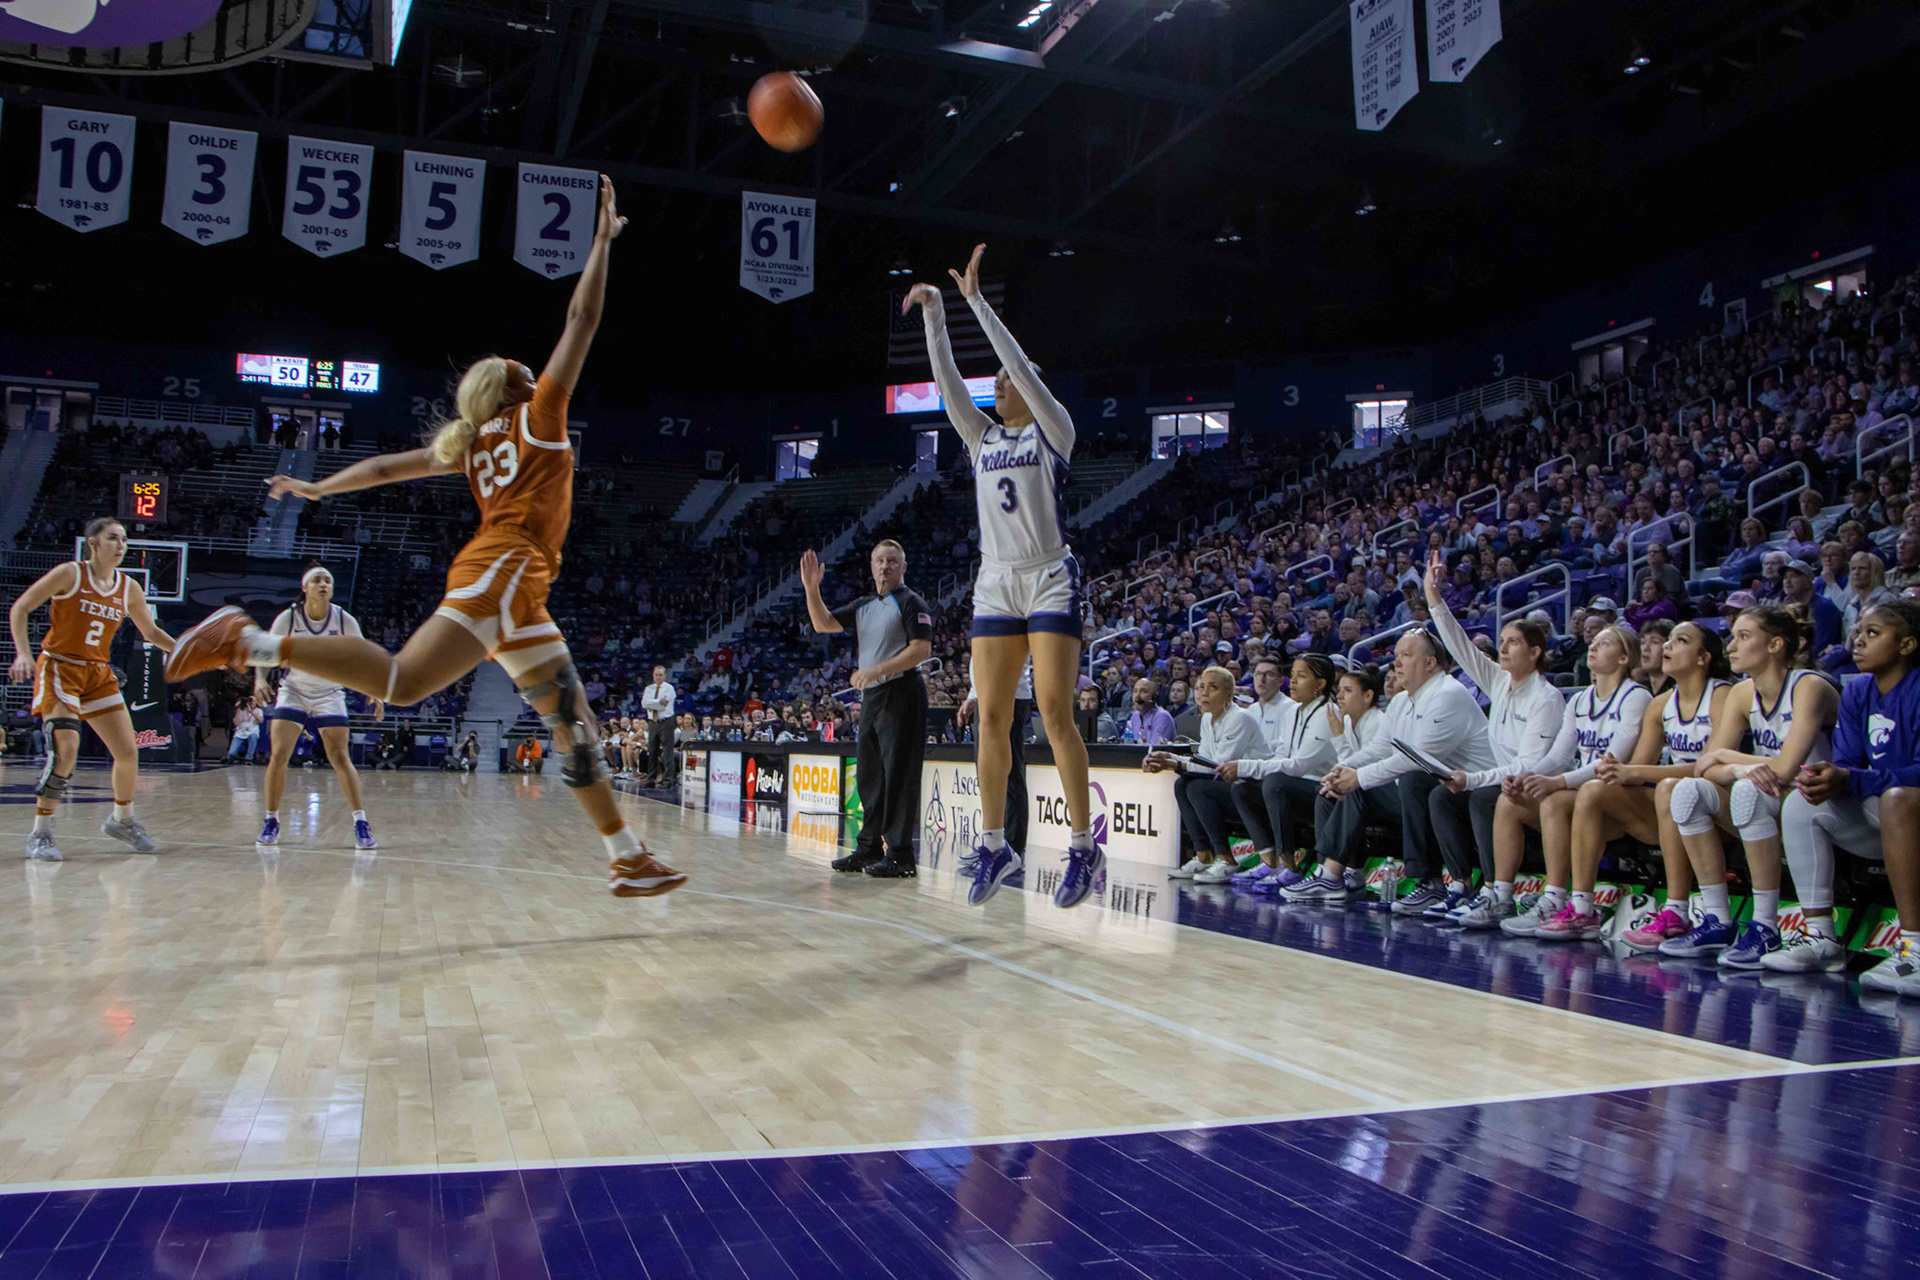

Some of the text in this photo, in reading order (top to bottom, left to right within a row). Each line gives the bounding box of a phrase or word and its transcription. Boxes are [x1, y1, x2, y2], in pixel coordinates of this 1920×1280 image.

[1463, 6, 1481, 26] 2023
[1370, 13, 1394, 41] AIAW
[1437, 23, 1455, 43] 2007
[1437, 37, 1455, 56] 2013
[68, 119, 110, 134] GARY
[188, 134, 238, 150] OHLDE
[50, 137, 123, 193] 10
[302, 147, 359, 165] WECKER
[191, 153, 227, 205] 3
[414, 161, 474, 179] LEHNING
[522, 172, 595, 190] CHAMBERS
[292, 165, 362, 220] 53
[59, 198, 109, 212] 1981-83
[424, 181, 457, 230] 5
[747, 201, 811, 217] AYOKA LEE
[182, 211, 231, 226] 2000-04
[539, 192, 571, 242] 2
[301, 223, 348, 238] 2001-05
[751, 217, 800, 260] 61
[416, 237, 461, 250] 2005-09
[531, 247, 575, 261] 2009-13
[744, 259, 767, 268] NCAA
[768, 262, 804, 272] DIVISION
[757, 273, 797, 285] 1/23/2022
[1699, 282, 1715, 308] 4
[278, 366, 300, 381] 50
[1492, 354, 1505, 377] 3
[163, 376, 200, 397] 25
[241, 374, 256, 382] 2:41
[349, 372, 371, 386] 47
[1283, 385, 1300, 406] 3
[1103, 398, 1117, 417] 2
[658, 417, 691, 437] 27
[832, 419, 838, 437] 1
[473, 440, 518, 499] 23
[981, 449, 1041, 474] Wildcats
[133, 483, 160, 496] 6:25
[997, 476, 1019, 514] 3
[136, 495, 156, 517] 12
[80, 599, 122, 622] TEXAS
[84, 620, 105, 646] 2
[143, 651, 151, 700] WILDCATS
[793, 764, 839, 799] QDOBA
[951, 768, 980, 796] Asce
[825, 796, 838, 806] EATS
[951, 806, 970, 835] Via
[1113, 801, 1158, 837] BELL
